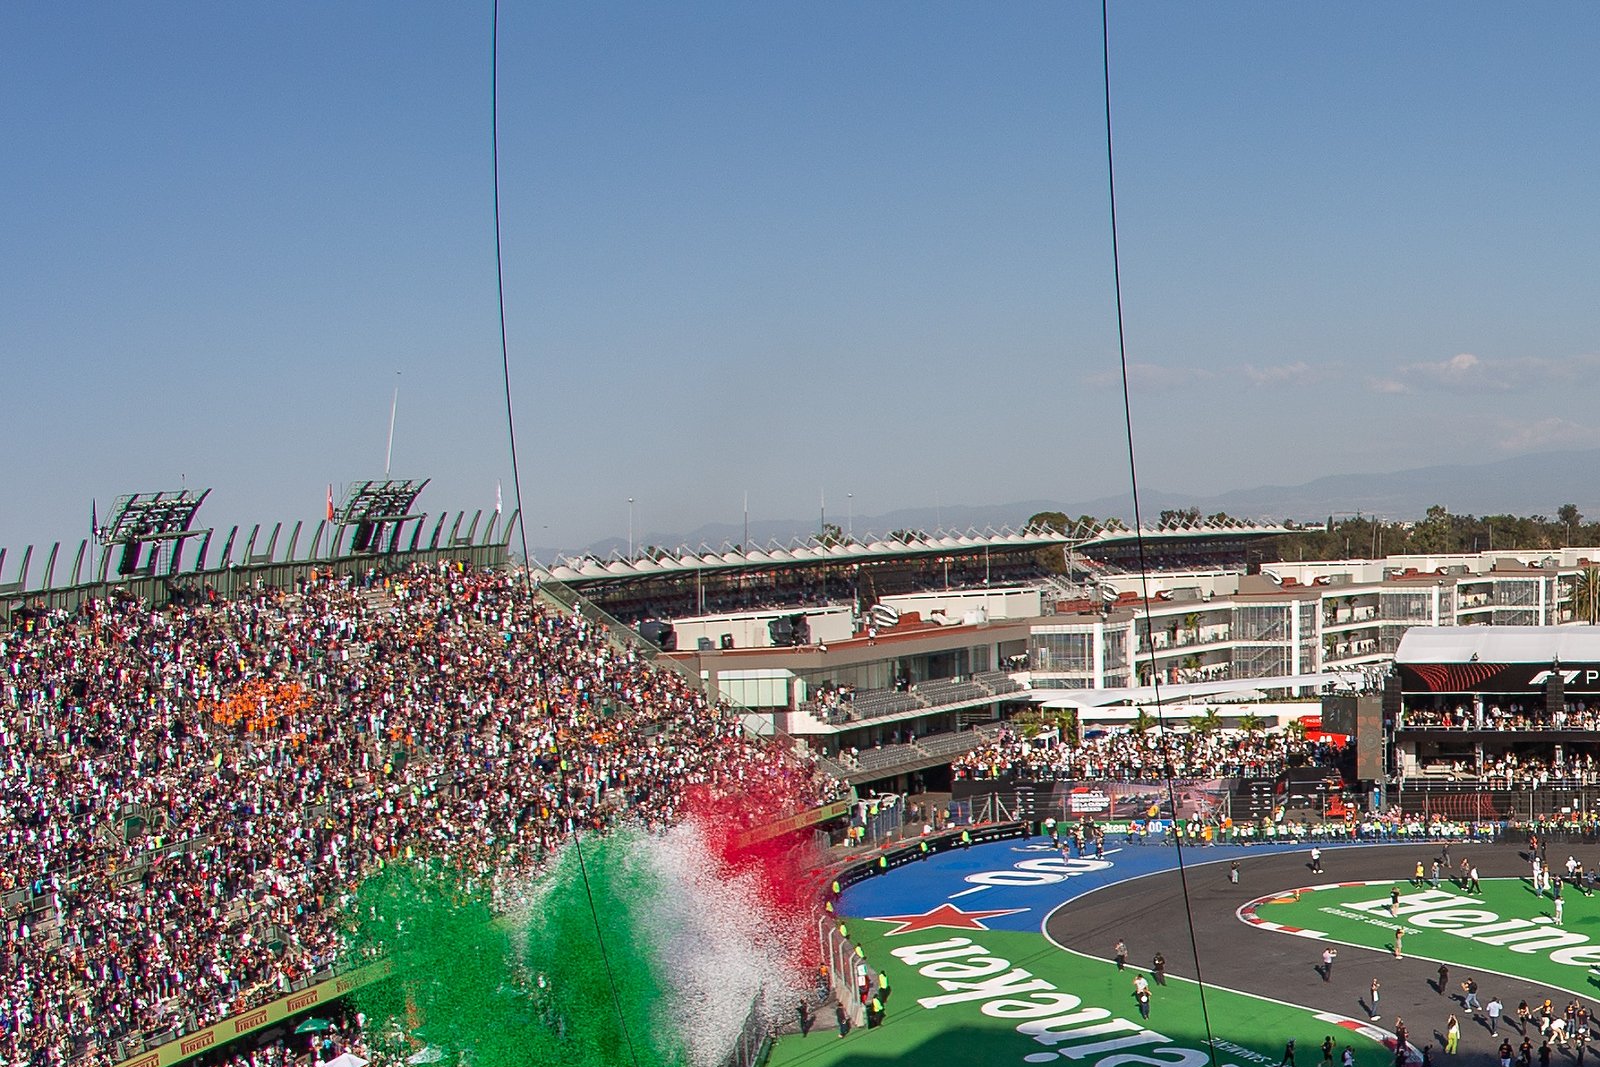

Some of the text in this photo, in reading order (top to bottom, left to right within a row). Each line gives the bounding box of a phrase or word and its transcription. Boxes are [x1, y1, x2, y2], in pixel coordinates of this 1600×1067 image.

[1100, 822, 1127, 833] eken
[235, 1010, 267, 1034] PIRELLI
[181, 1030, 216, 1056] PIRELLI
